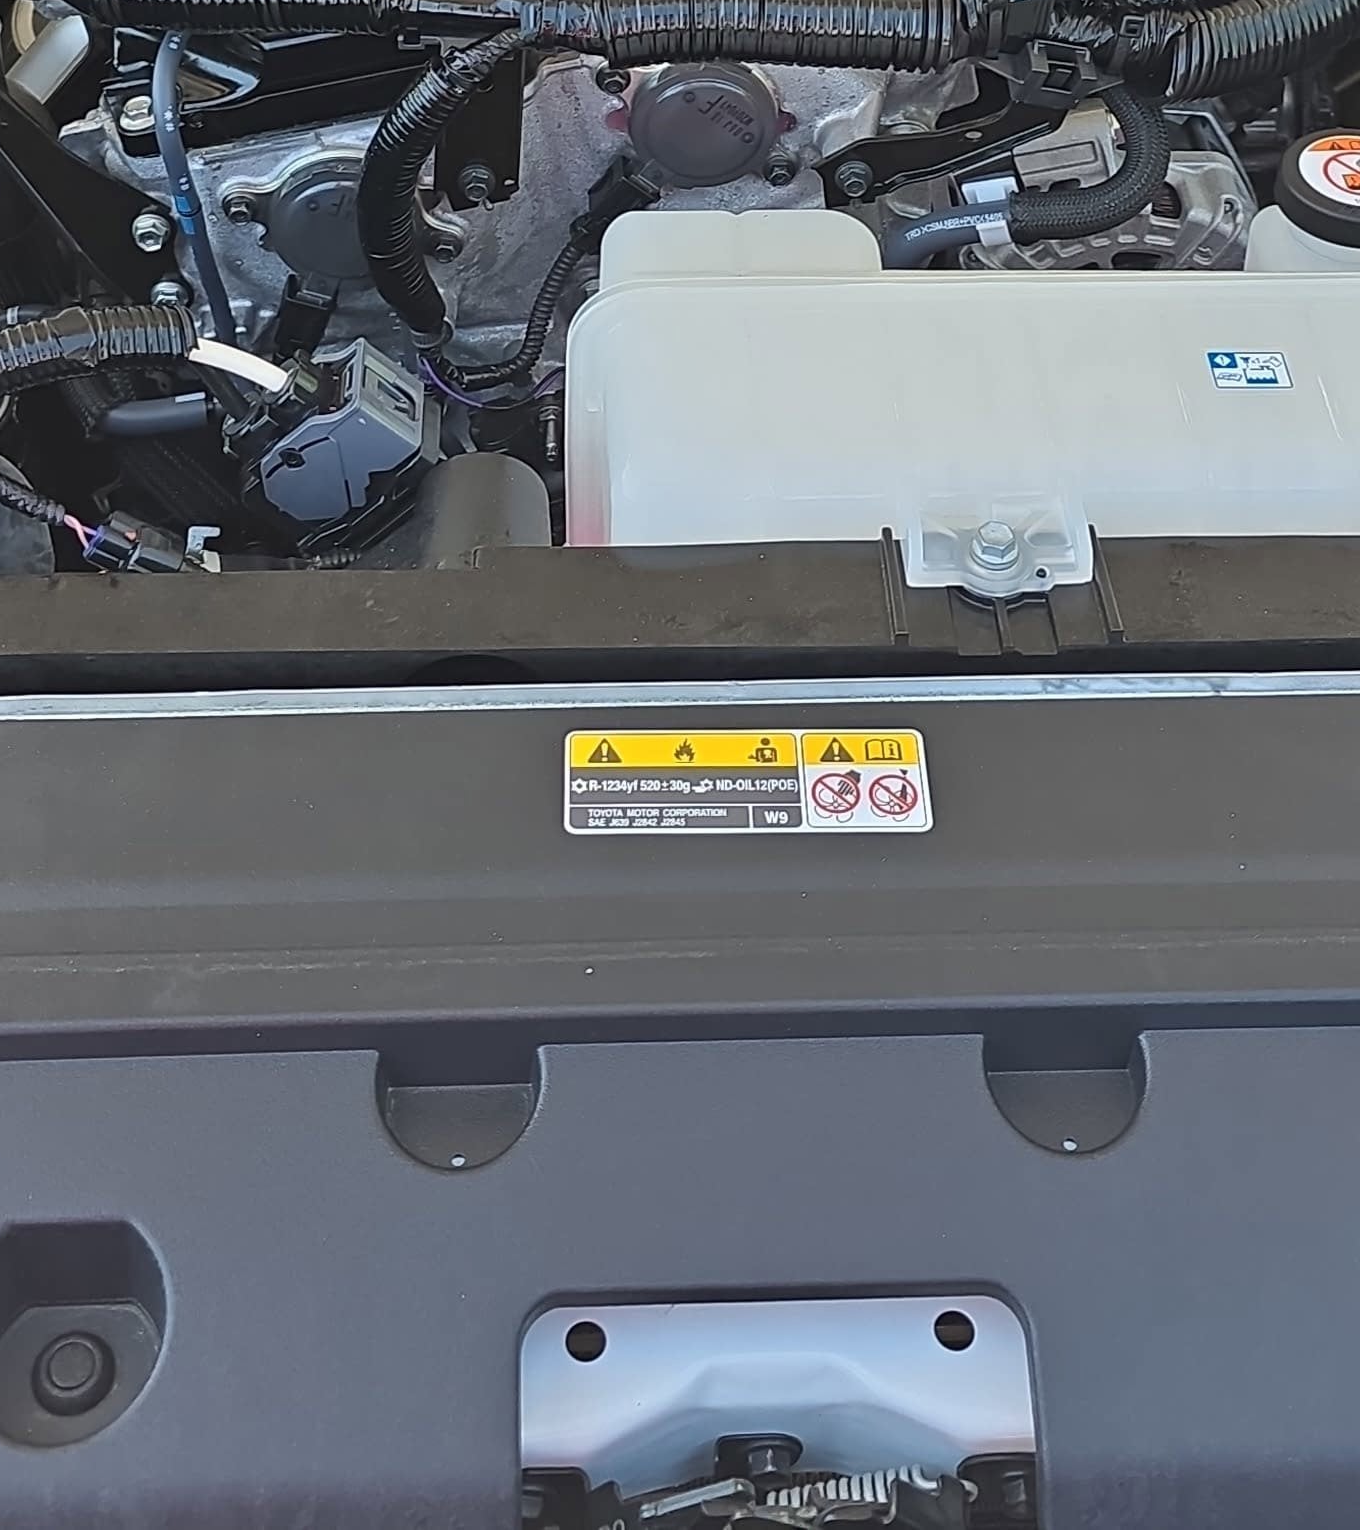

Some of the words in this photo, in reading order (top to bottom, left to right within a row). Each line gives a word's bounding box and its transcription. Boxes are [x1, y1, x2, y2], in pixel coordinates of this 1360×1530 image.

[587, 779, 639, 794] R-1234yf
[639, 779, 691, 795] 520±30g
[715, 779, 799, 794] ND-OIL12(POE)
[587, 808, 624, 818] TOYOTA
[626, 808, 660, 818] MOTOR
[662, 808, 728, 818] CORPORATION
[764, 811, 789, 824] W9
[587, 817, 607, 827] SAE
